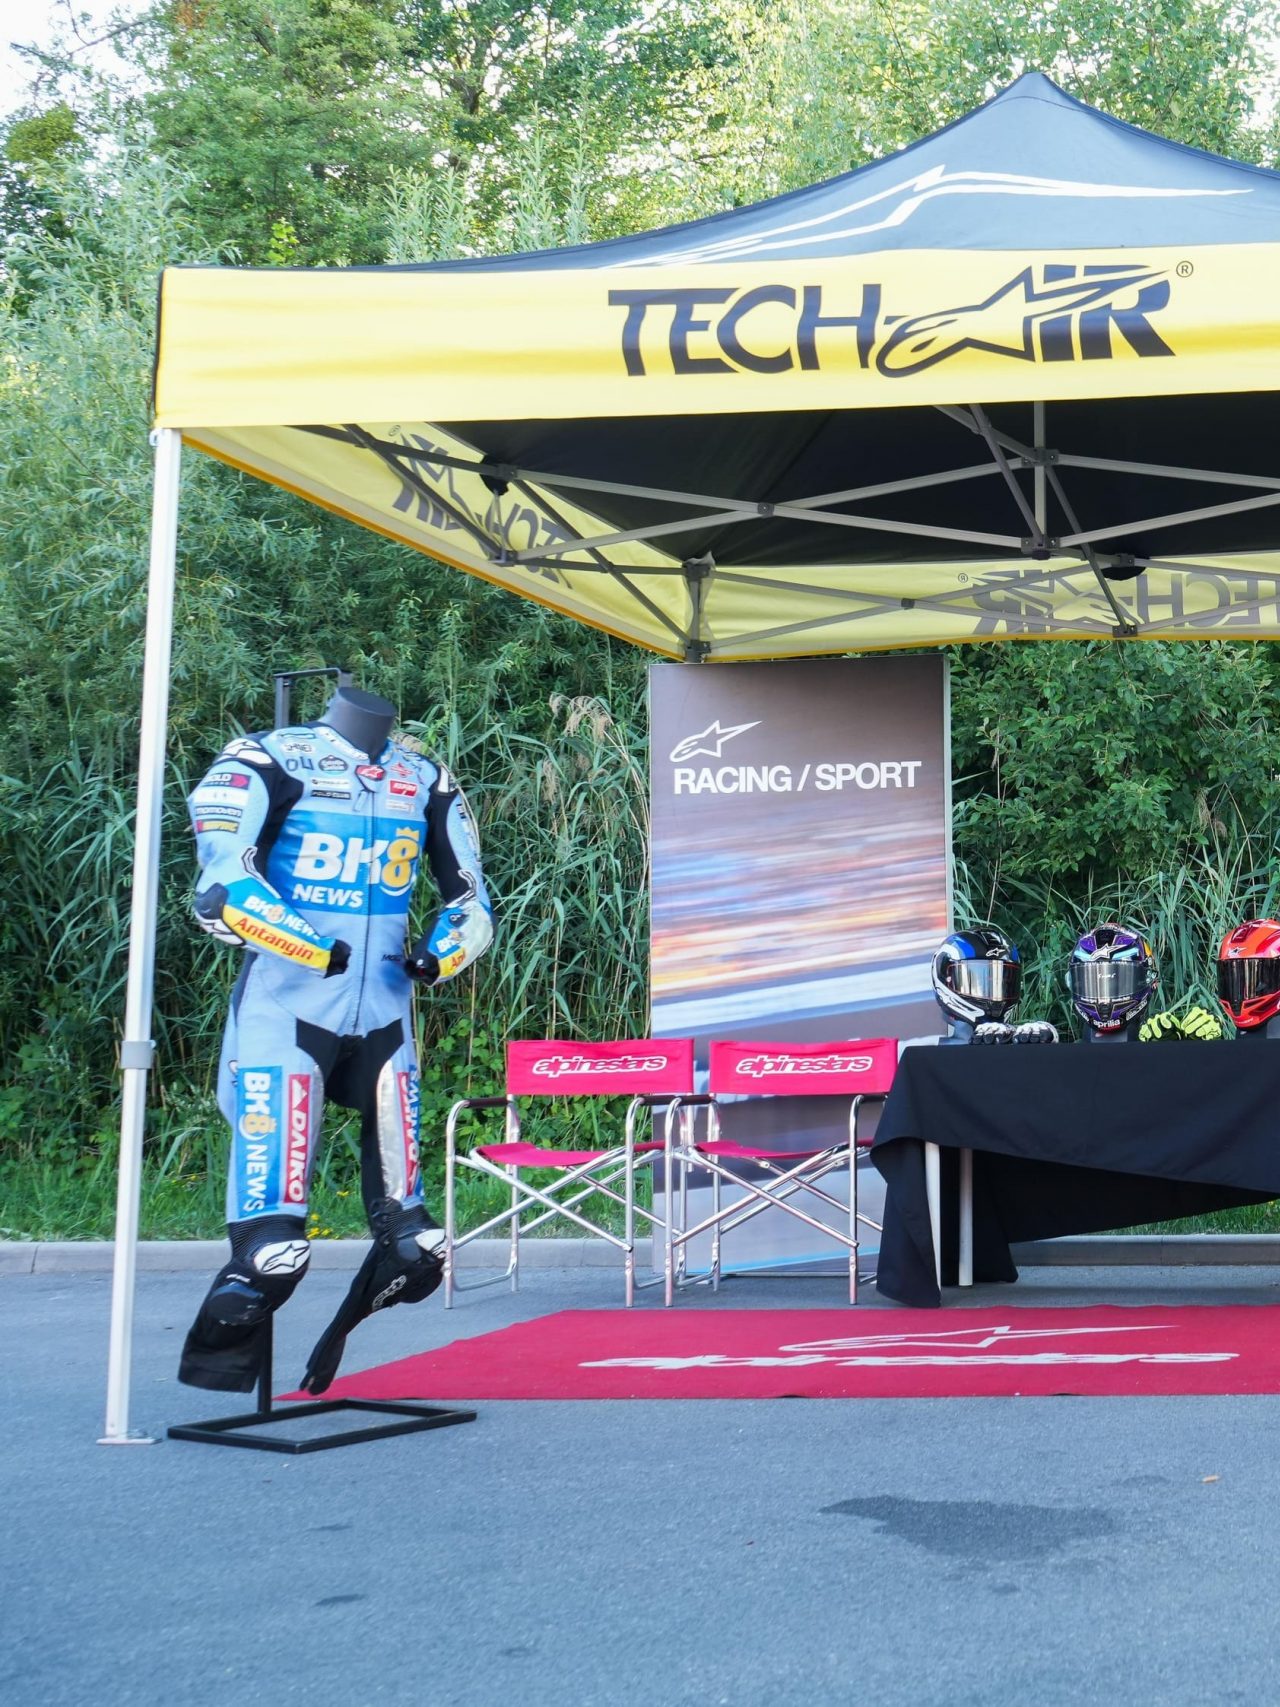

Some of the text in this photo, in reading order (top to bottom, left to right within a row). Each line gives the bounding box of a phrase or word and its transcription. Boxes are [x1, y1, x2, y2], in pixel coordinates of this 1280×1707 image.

[673, 764, 793, 795] RACING
[814, 760, 923, 791] SPORT
[291, 827, 420, 889] BK8
[292, 882, 364, 909] NEWS
[233, 916, 315, 961] Antangin
[532, 1055, 668, 1078] alpinestars
[735, 1054, 873, 1078] alpinestars
[242, 1071, 274, 1213] BK8 NEWS
[288, 1109, 307, 1203] DAIKO
